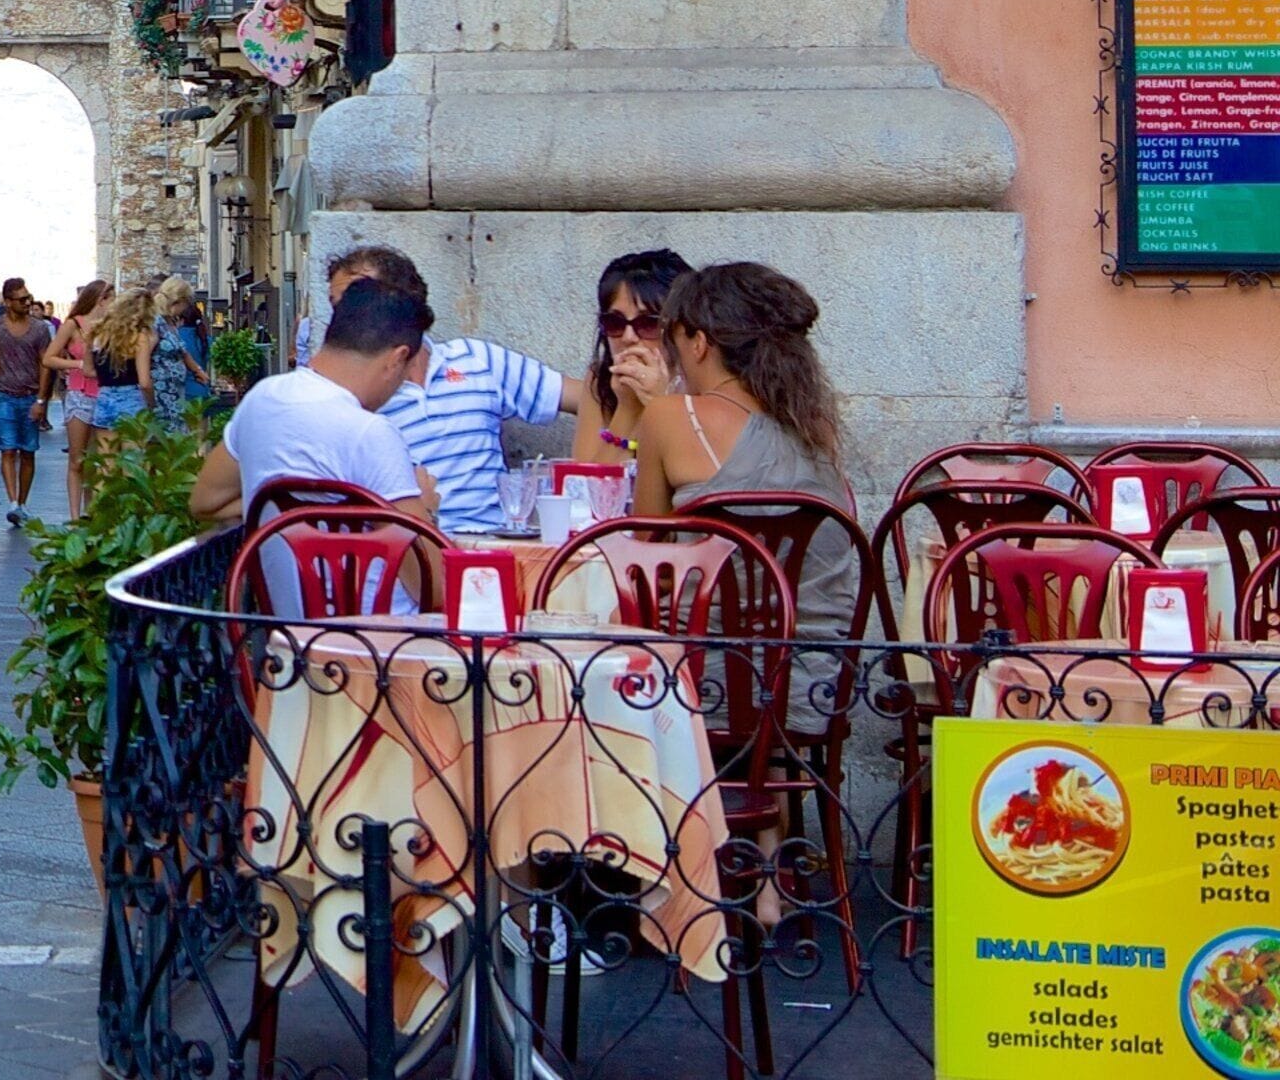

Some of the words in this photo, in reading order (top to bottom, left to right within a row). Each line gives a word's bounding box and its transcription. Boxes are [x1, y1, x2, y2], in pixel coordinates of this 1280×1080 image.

[1188, 49, 1238, 59] BRANDY
[1186, 61, 1222, 71] KIRSH
[1227, 61, 1253, 70] RUM
[1137, 138, 1178, 147] SUCCHI
[1181, 138, 1194, 147] DI
[1197, 137, 1240, 147] FRUTTA
[1137, 149, 1158, 159] JUS
[1162, 149, 1176, 159] DE
[1180, 149, 1220, 159] FRUITS
[1137, 161, 1175, 170] FRUITS
[1178, 161, 1209, 170] JUISE
[1137, 172, 1179, 181] FRUCHT
[1184, 172, 1214, 181] SAFT
[1169, 189, 1209, 199] COFFEE
[1155, 202, 1196, 212] COFFEE
[1138, 229, 1199, 238] OCKTAILS
[1173, 242, 1218, 251] DRINKS
[1150, 763, 1229, 788] PRIMI
[1196, 830, 1276, 849] pastas
[1202, 852, 1270, 879] pâtes
[1201, 884, 1270, 904] pasta
[976, 937, 1092, 965] INSALATE
[1097, 944, 1166, 969] MISTE
[1033, 978, 1109, 1000] salads
[1029, 1007, 1118, 1029] salades
[987, 1029, 1104, 1052] gemischter
[1110, 1035, 1164, 1055] salat
